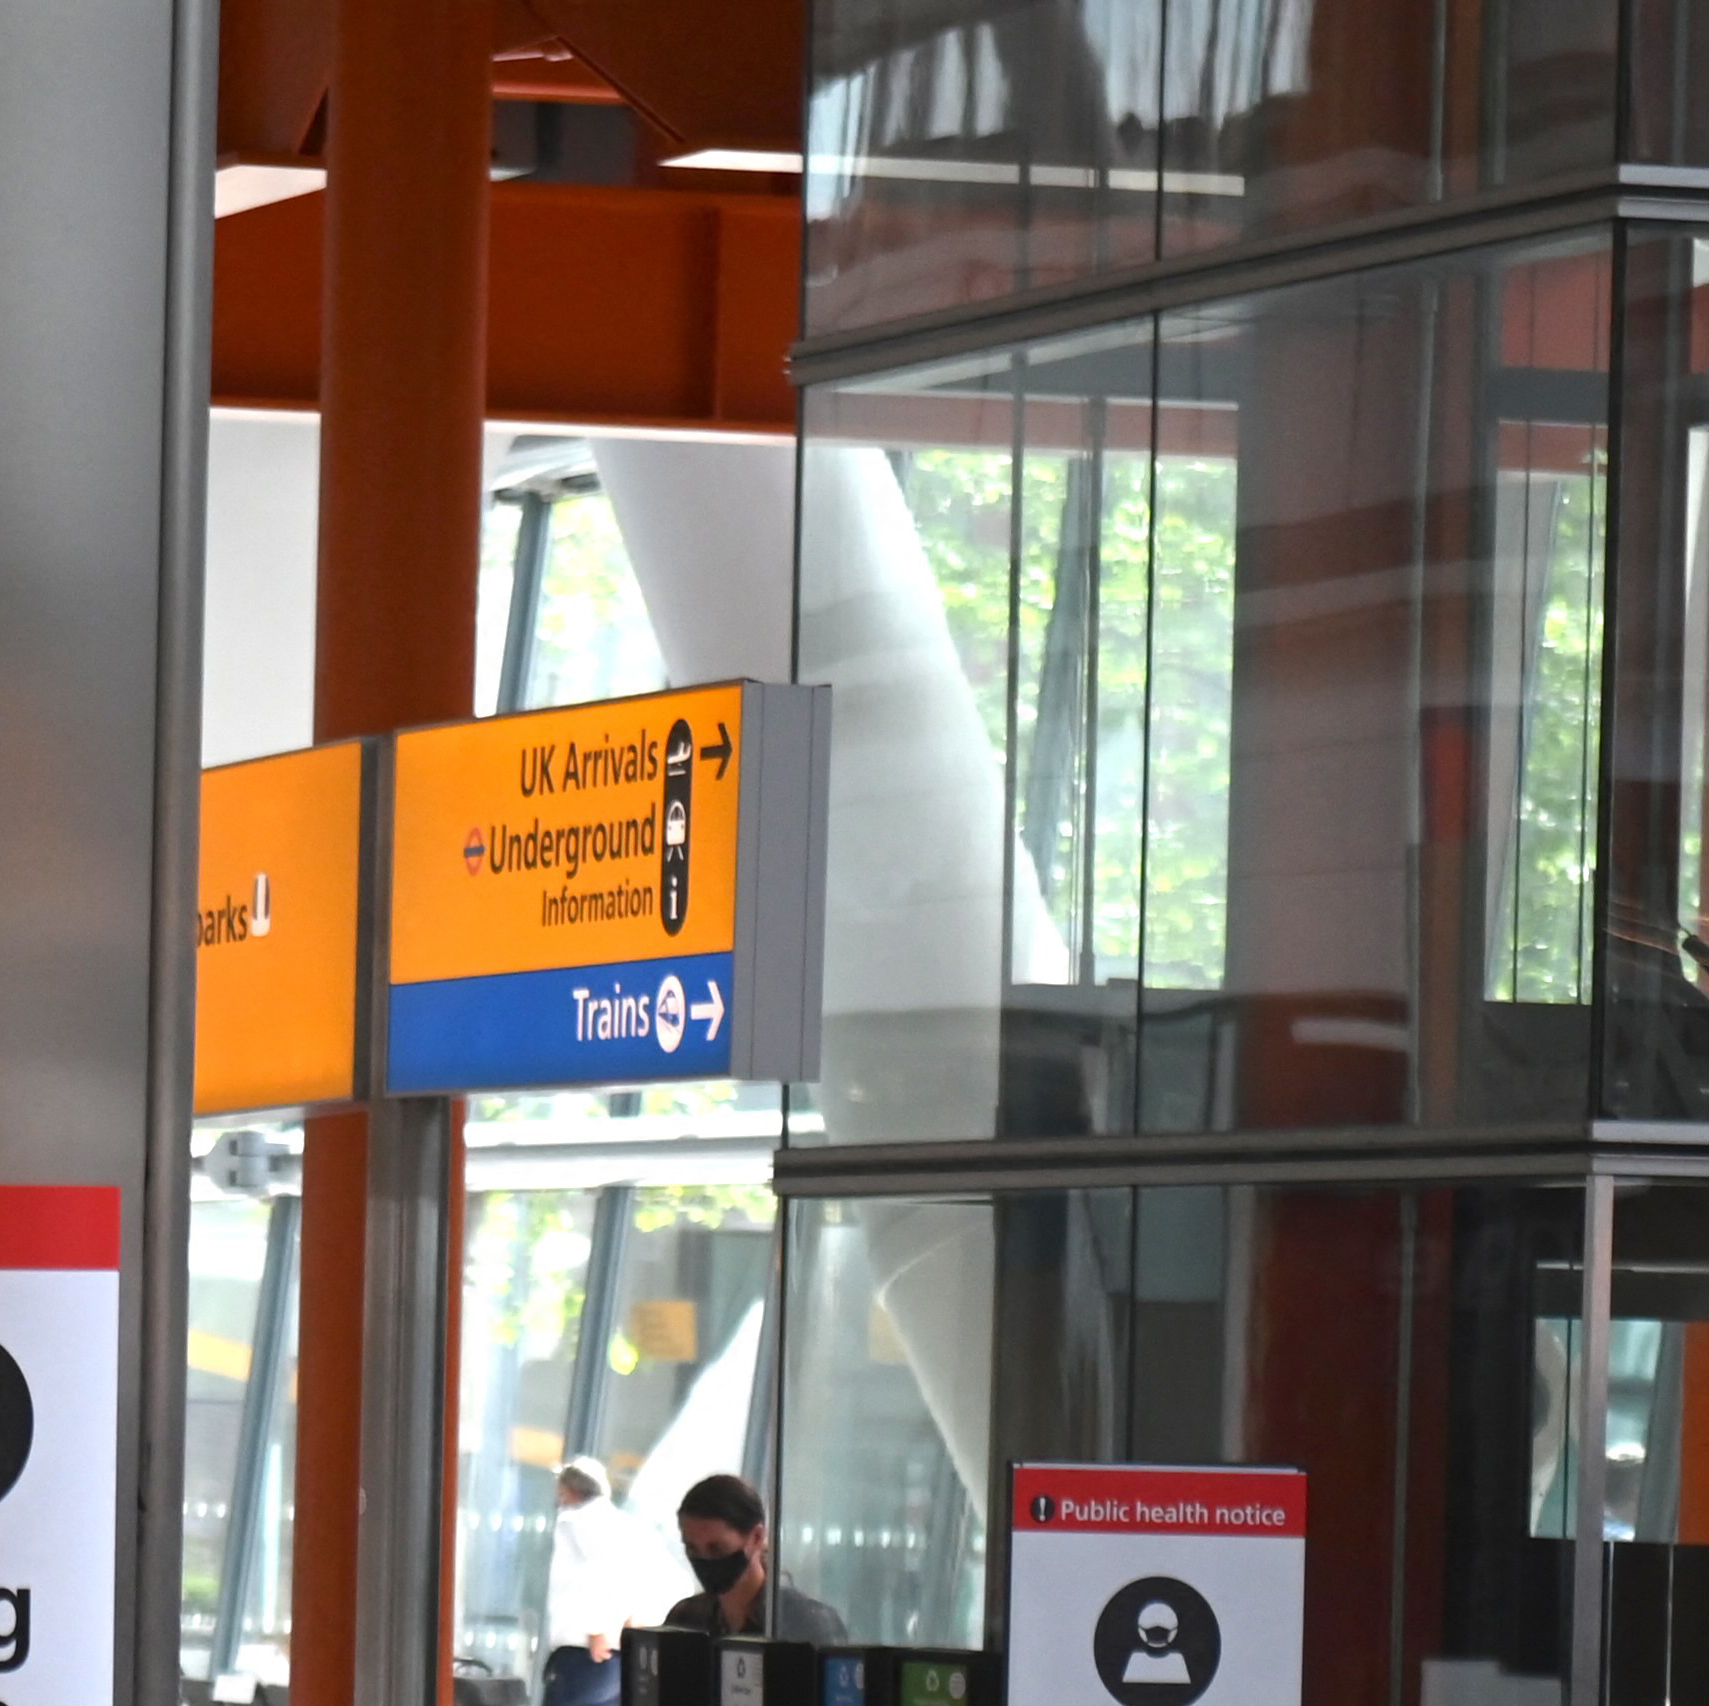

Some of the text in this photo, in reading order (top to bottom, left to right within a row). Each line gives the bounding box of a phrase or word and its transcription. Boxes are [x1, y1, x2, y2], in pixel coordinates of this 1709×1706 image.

[520, 728, 658, 798] UK Arrivals
[489, 802, 656, 879] Underground
[541, 878, 654, 927] Information
[572, 981, 650, 1042] Trains
[1061, 1501, 1286, 1527] Public health notice
